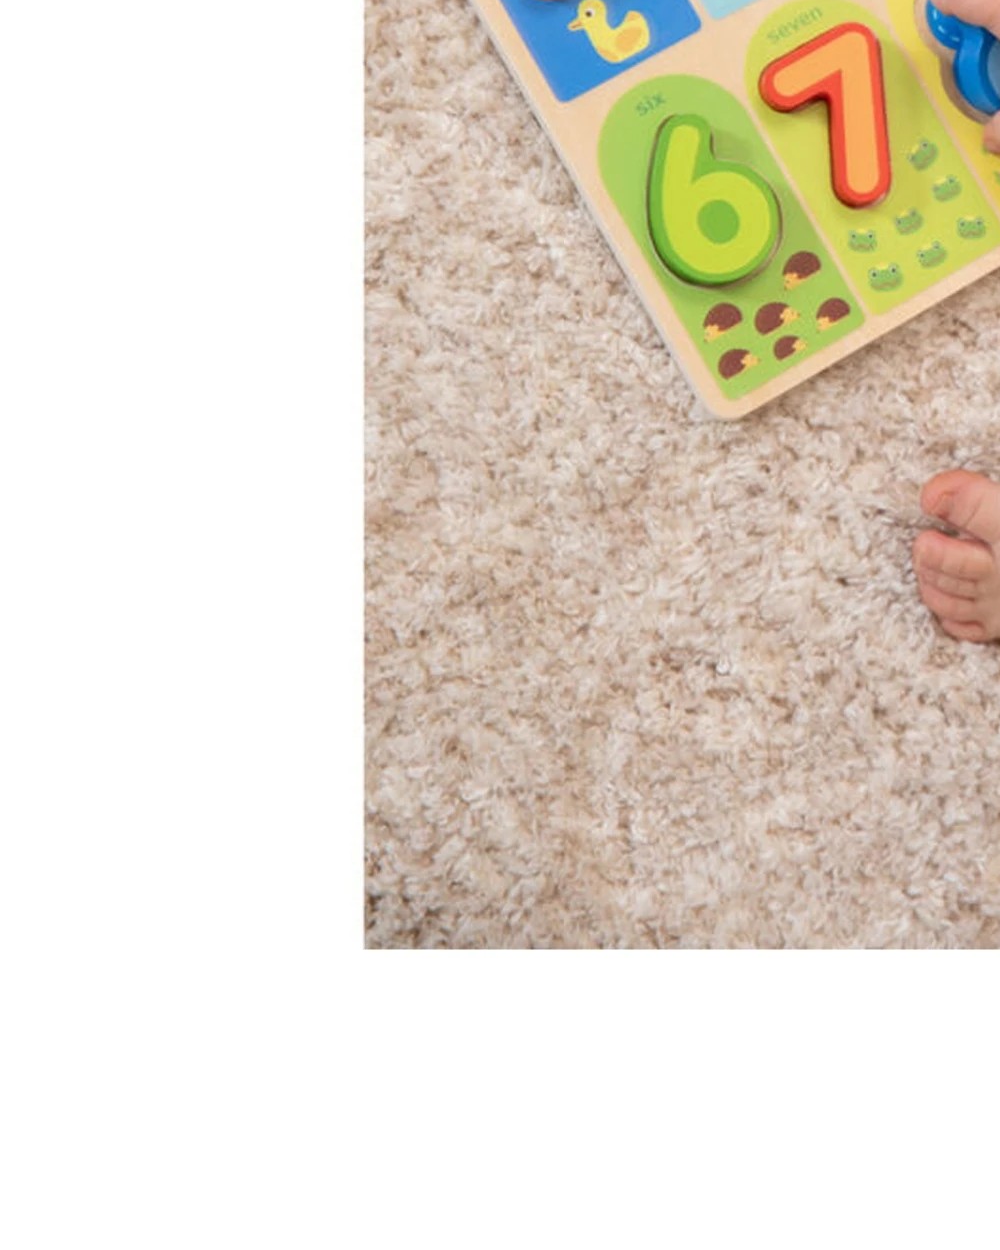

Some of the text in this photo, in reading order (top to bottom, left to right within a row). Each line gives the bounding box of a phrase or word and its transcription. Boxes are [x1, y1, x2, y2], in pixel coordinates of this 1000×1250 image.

[767, 5, 823, 45] seven
[635, 92, 665, 118] six
[766, 31, 887, 201] 7
[656, 120, 774, 280] 6
